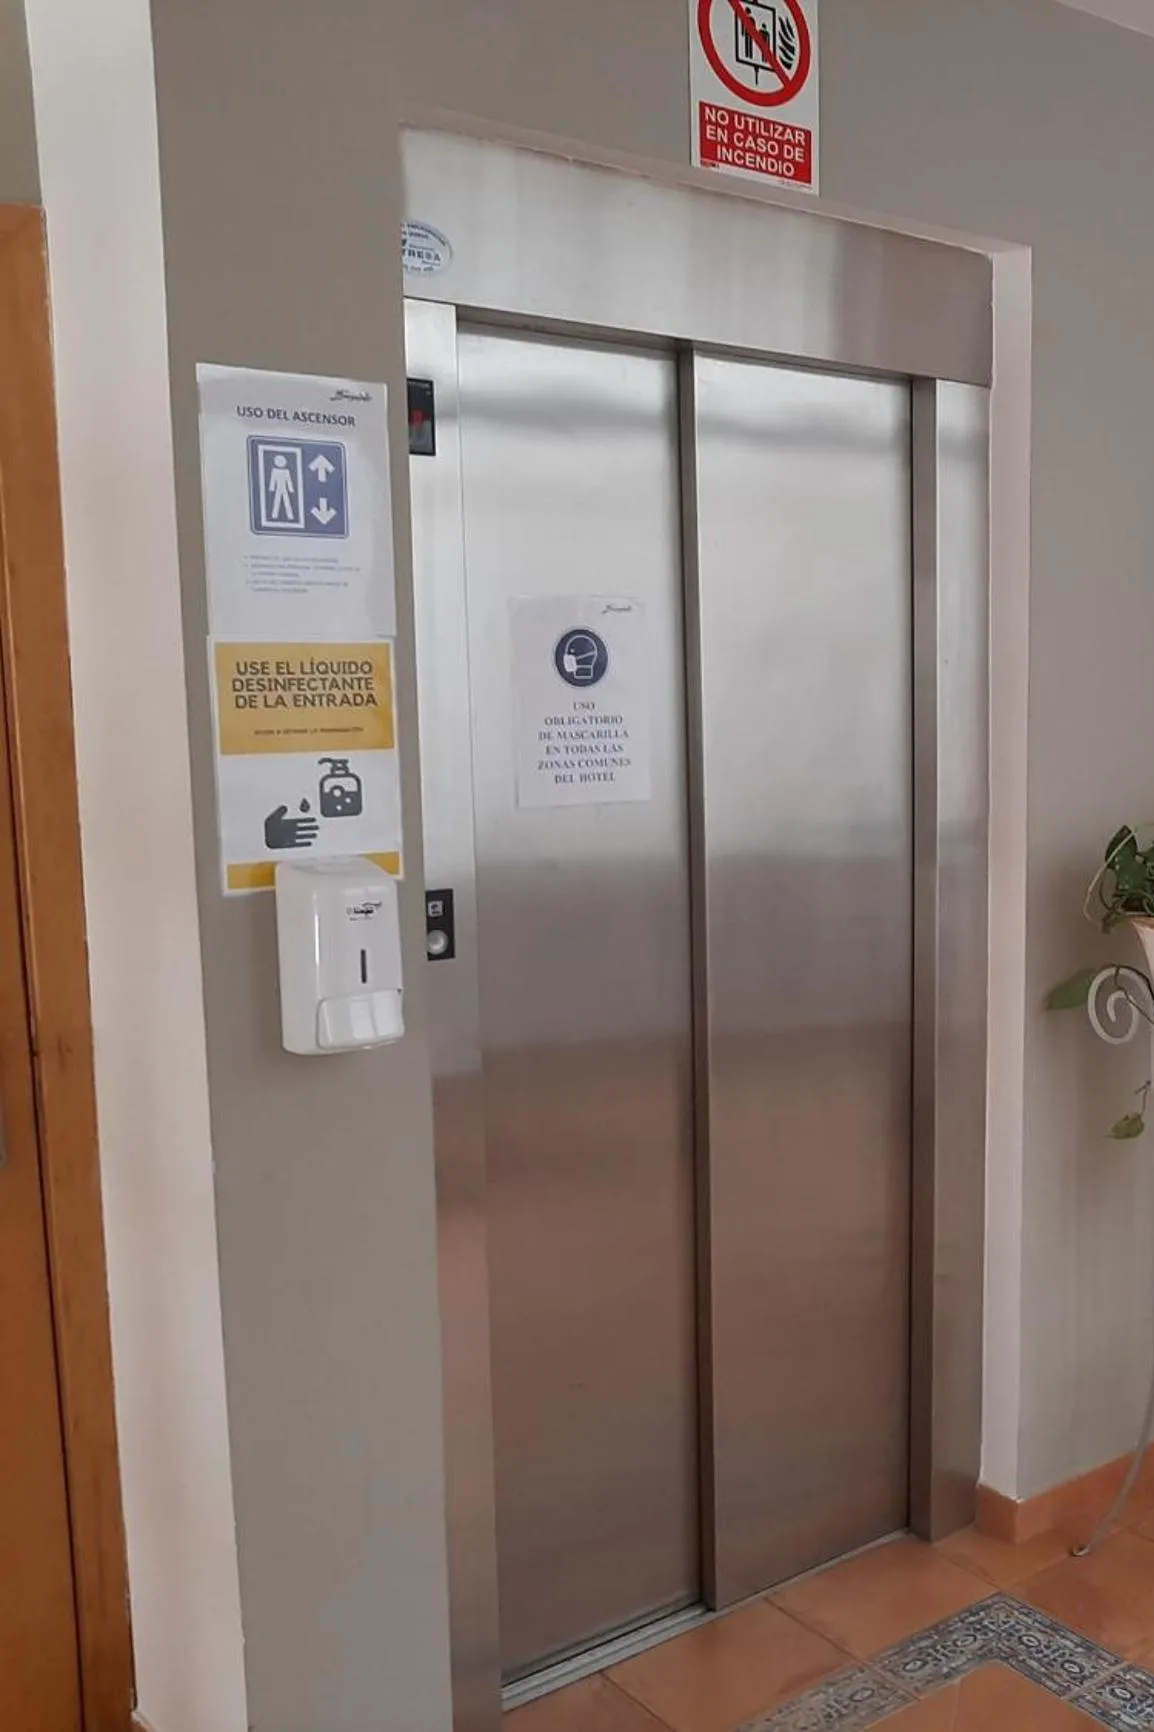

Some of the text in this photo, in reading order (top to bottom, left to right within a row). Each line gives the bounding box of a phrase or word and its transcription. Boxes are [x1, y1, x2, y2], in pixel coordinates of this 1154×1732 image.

[704, 106, 806, 145] NO UTILIZAR
[705, 125, 805, 162] EN CASO DE
[717, 144, 795, 177] INCENDIO
[236, 405, 356, 427] USO DEL ASCENSOR
[236, 656, 373, 676] USE EL LÍQUIDO
[232, 676, 374, 693] DESINFECTANTE
[234, 692, 378, 709] DE LA ENTRADA
[573, 701, 595, 710] USO
[544, 715, 623, 726] OBLIGATORIO
[538, 729, 629, 741] DE MASCARILLA
[545, 743, 624, 755] EN TODAS LAS
[537, 758, 631, 770] ZONAS COMUNES
[554, 772, 615, 784] DEL HOTEL
